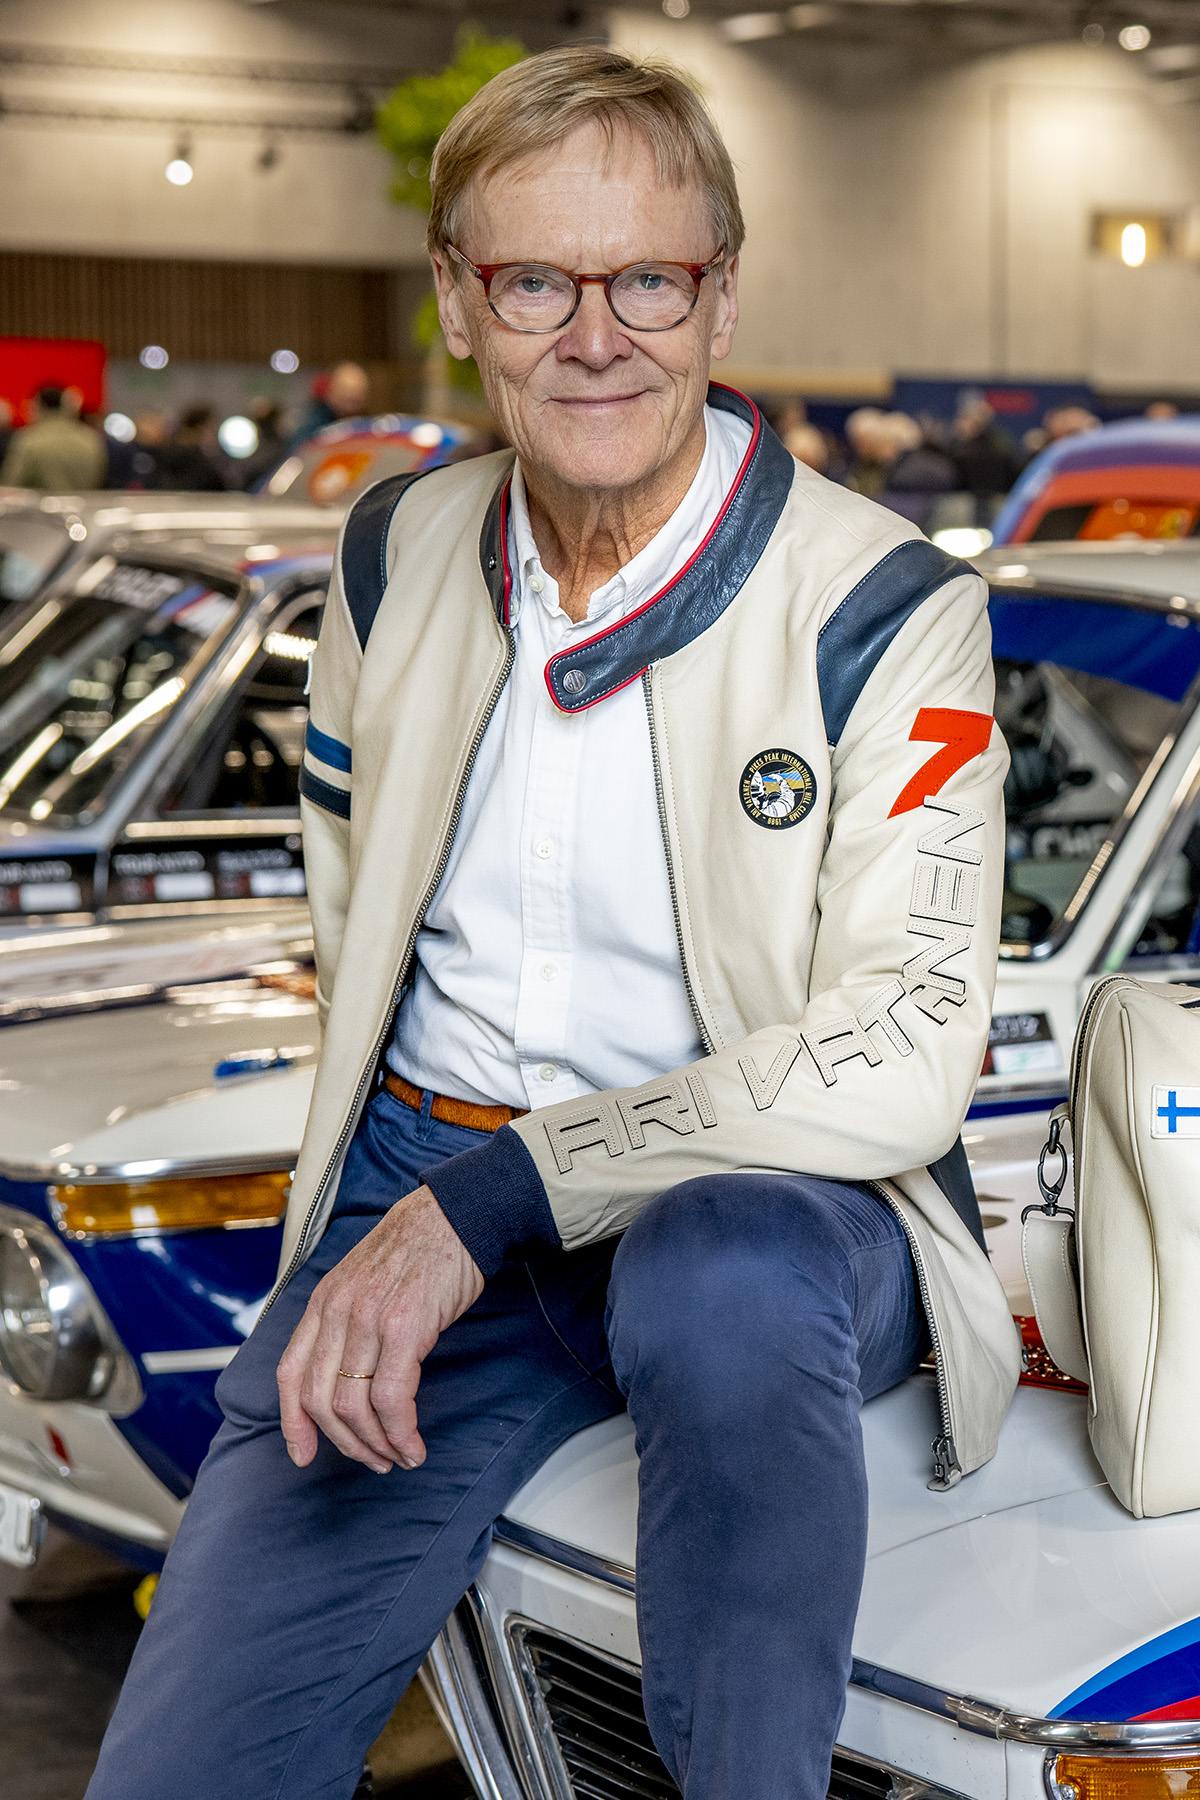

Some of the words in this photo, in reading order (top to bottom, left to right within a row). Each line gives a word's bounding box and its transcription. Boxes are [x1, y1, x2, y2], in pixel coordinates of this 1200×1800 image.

[749, 757, 764, 774] PIKES
[764, 752, 780, 762] PEAK
[887, 708, 995, 819] 7
[781, 753, 813, 789] INTERNATIONAL
[743, 779, 753, 809] VATANEN
[804, 792, 813, 805] HILL
[750, 808, 762, 818] ARI
[788, 807, 807, 822] CLIMB
[543, 1069, 717, 1175] ARI
